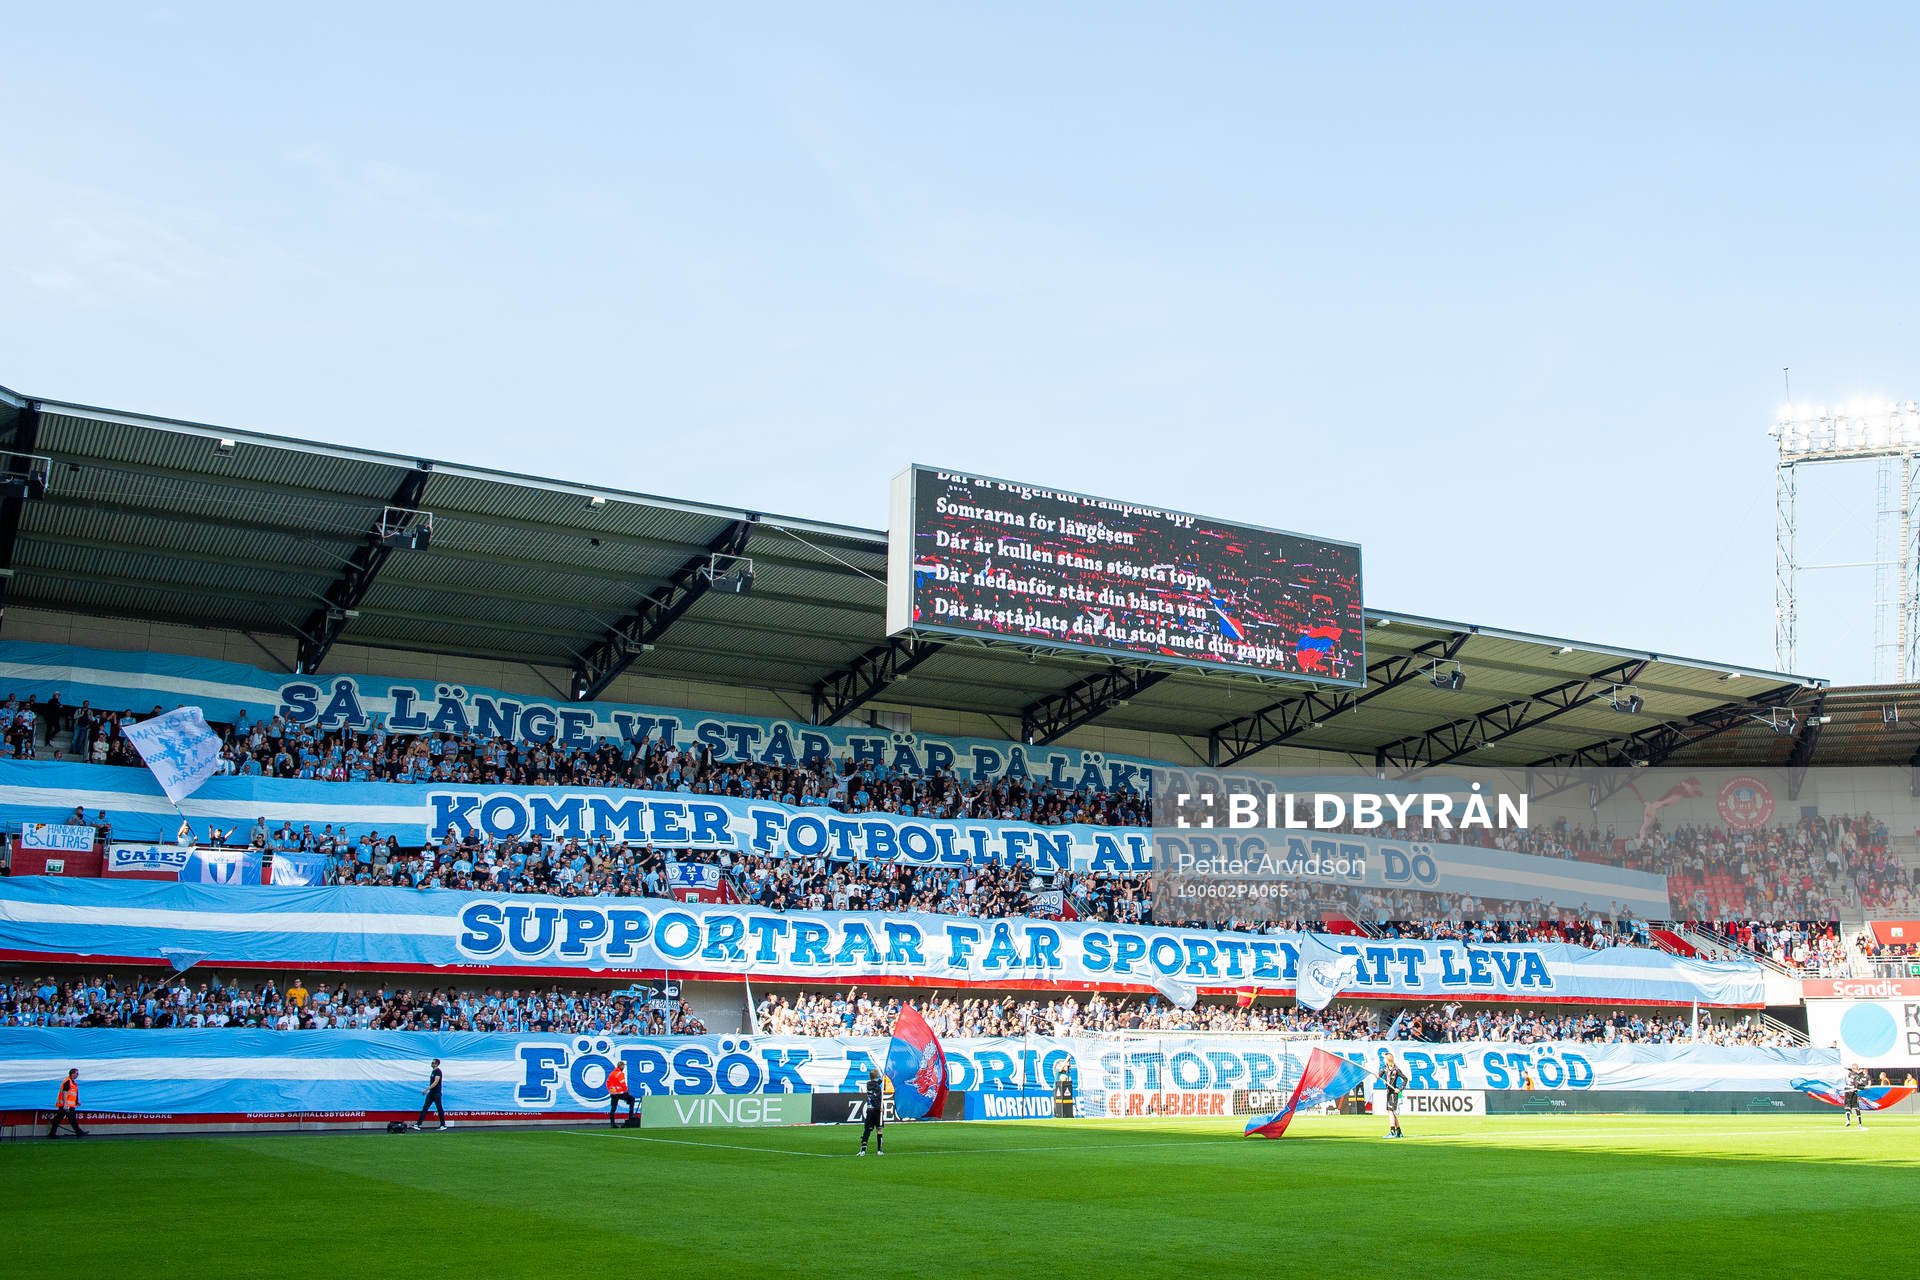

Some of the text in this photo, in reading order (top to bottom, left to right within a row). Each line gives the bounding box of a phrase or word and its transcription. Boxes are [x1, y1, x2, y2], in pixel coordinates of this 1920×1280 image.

[936, 497, 1135, 545] Somrarna för längesen
[936, 530, 1208, 592] Där är kullen stans största topp
[936, 564, 1207, 620] Där nedanför står din bästa vän
[935, 597, 1285, 665] Där är ståplats där du stod med din pappa
[278, 680, 367, 728] SÅ
[388, 686, 595, 750] LÄNGE
[613, 714, 678, 750] VI
[697, 723, 834, 769] STÅR
[848, 734, 957, 780] HÄR
[972, 746, 1031, 782] PÅ
[46, 834, 90, 849] ULTRAS
[47, 824, 94, 837] HANDIKAPP
[431, 795, 1440, 885] KOMMER FOTBOLLEN ALDRIG ATT DÖ
[461, 904, 928, 966] SUPPORTRAR
[947, 922, 1064, 970] FÅR
[1083, 931, 1301, 981] SPORTEN
[1440, 949, 1554, 988] LEVA
[1833, 980, 1902, 996] Scandic
[518, 1039, 817, 1100] FÖRSÖK
[1484, 1046, 1595, 1090] STÖD
[674, 1098, 783, 1124] VINGE
[1407, 1095, 1474, 1113] TEKNOS
